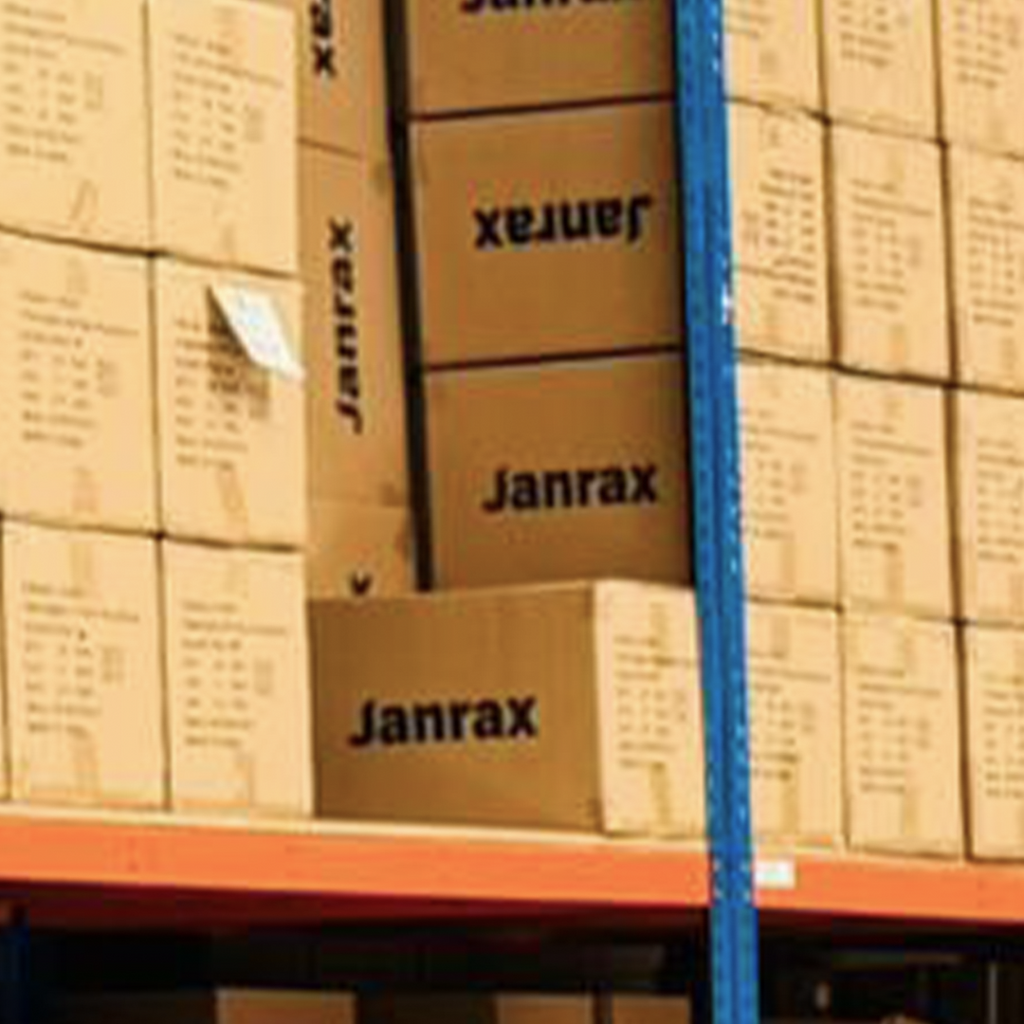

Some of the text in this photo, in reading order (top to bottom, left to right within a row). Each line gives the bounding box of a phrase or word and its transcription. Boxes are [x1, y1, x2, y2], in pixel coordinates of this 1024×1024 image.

[472, 196, 654, 249] Janrax
[329, 218, 363, 435] Janrax
[482, 463, 658, 513] Janrax
[347, 696, 538, 748] Janrax
